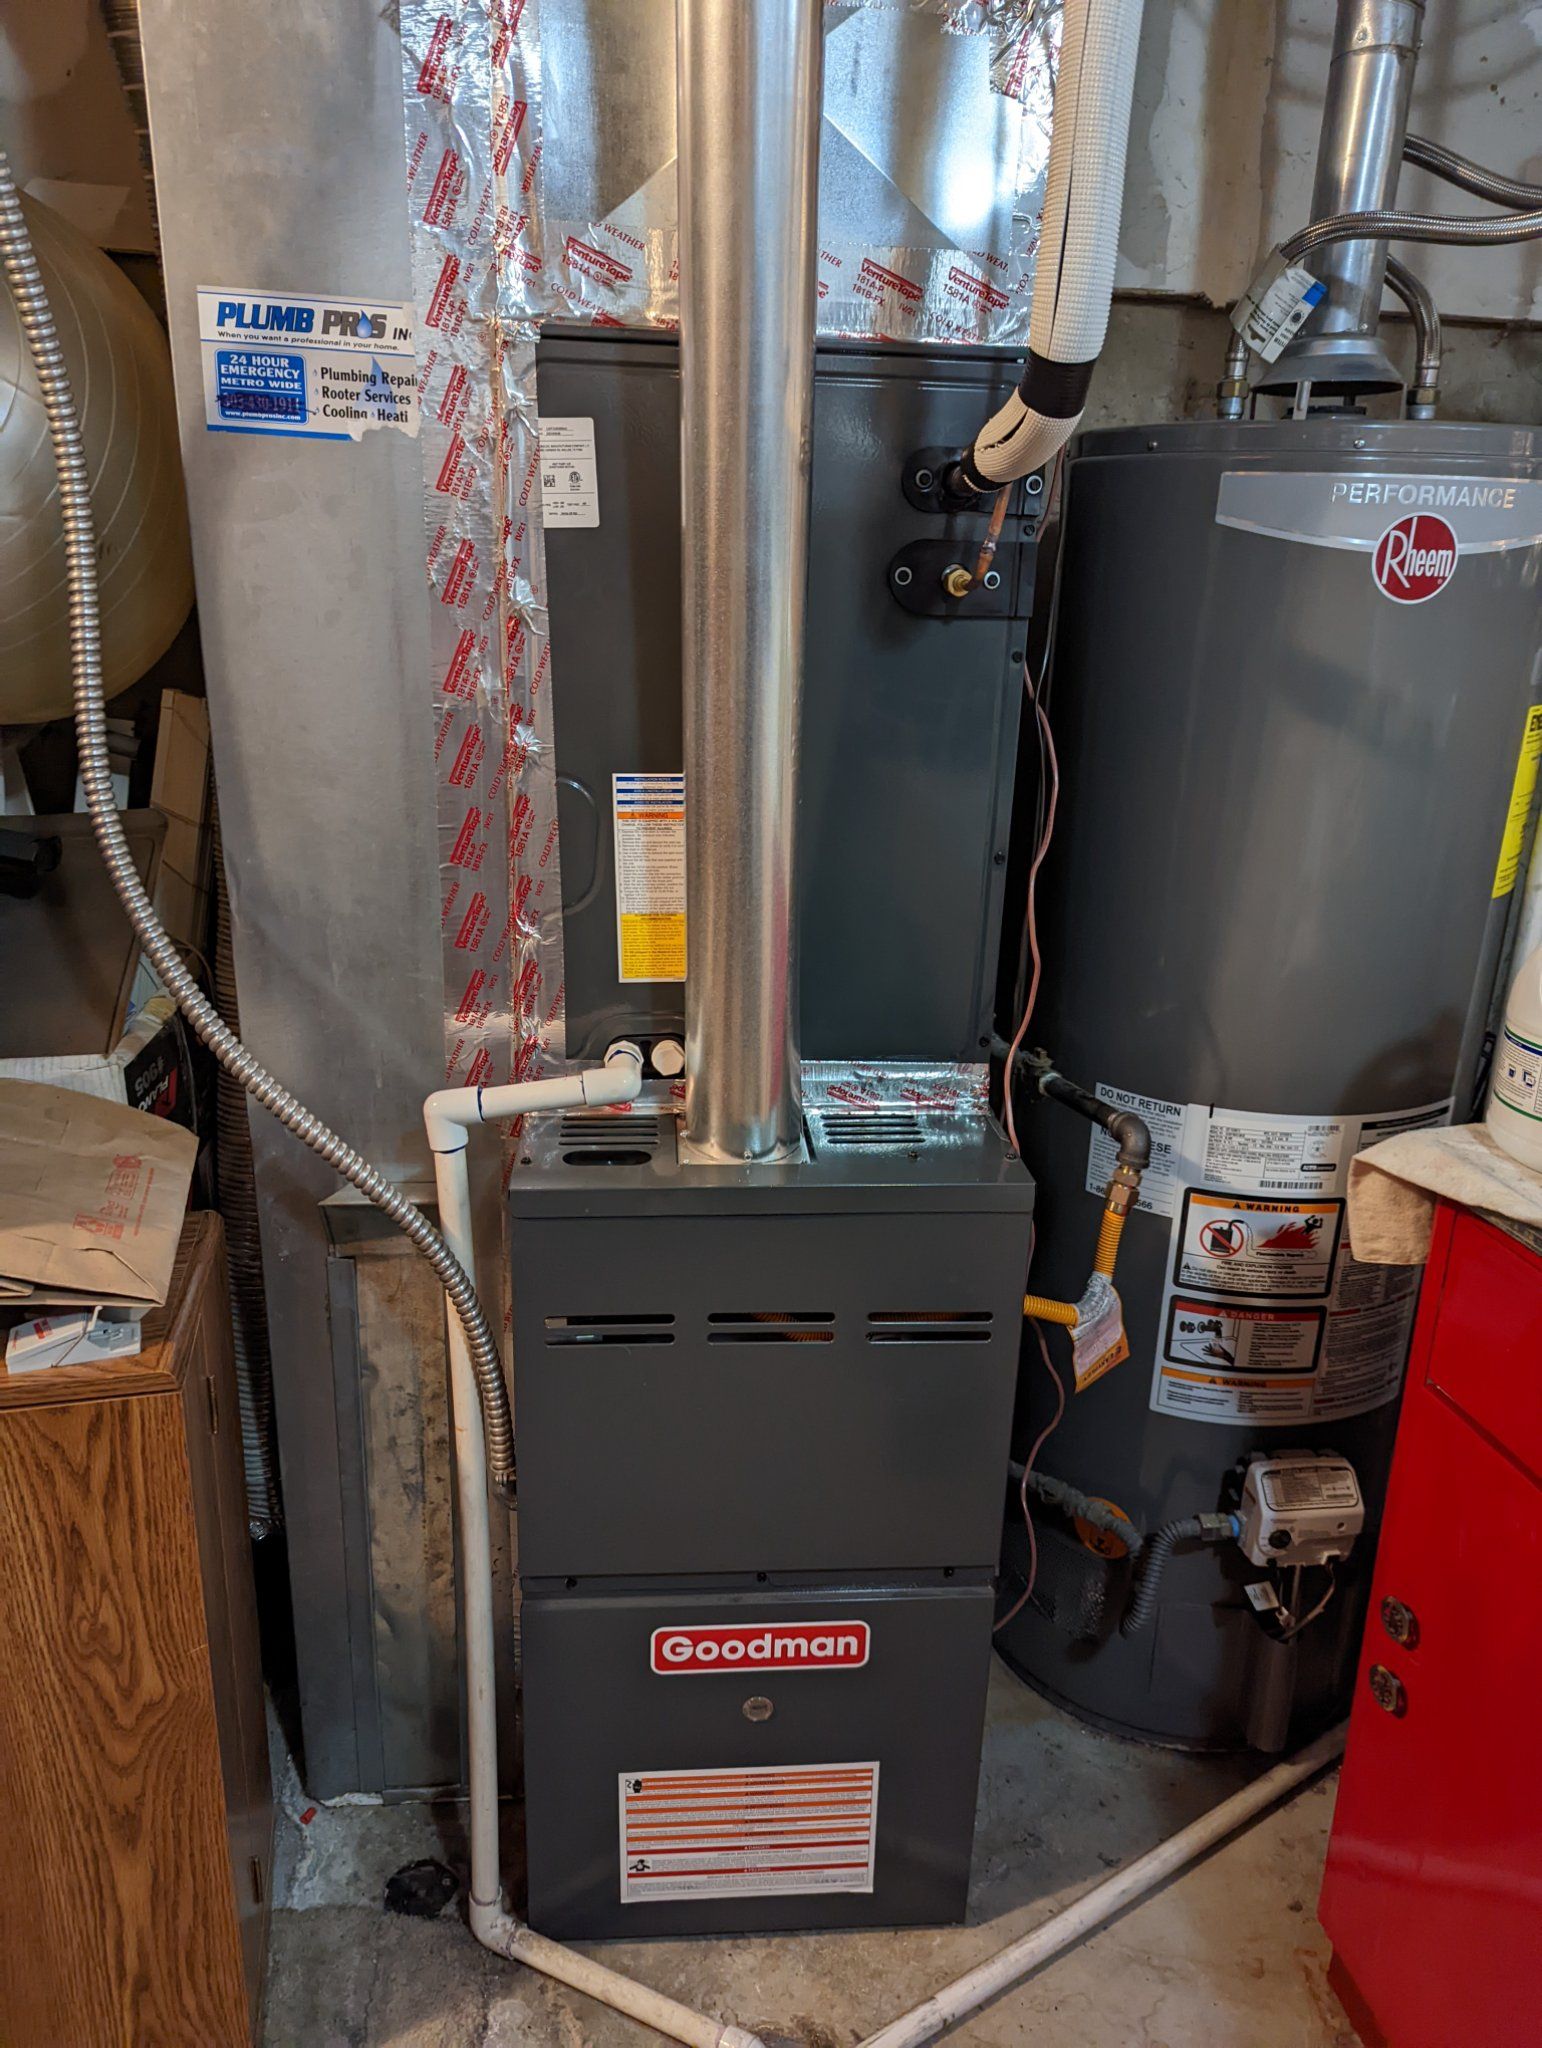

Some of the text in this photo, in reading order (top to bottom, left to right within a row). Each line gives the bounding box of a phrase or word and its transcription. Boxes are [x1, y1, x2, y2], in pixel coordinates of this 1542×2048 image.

[521, 145, 542, 193] WEATHER
[430, 151, 460, 226] VentureTape
[441, 198, 458, 231] 1581A
[467, 179, 493, 246] COLD WEAT
[603, 223, 645, 252] WEATHER
[566, 242, 633, 283] VentureTape
[820, 250, 842, 268] THER
[986, 253, 1009, 273] WEAT
[432, 254, 462, 328] VentureTape
[852, 283, 886, 307] 181B-FX
[857, 273, 886, 293] 181A-P
[861, 263, 923, 303] VentureTape
[943, 283, 969, 305] 1581A
[948, 271, 1009, 311] VentureTape
[551, 282, 609, 316] COLD WEAT
[899, 303, 917, 318] IV/21
[216, 301, 315, 334] PLUMB
[441, 298, 457, 333] 181A-P
[451, 298, 469, 338] 181B-FX
[291, 337, 342, 346] professional
[373, 343, 399, 351] home.
[221, 364, 300, 379] EMERGENCY
[230, 354, 289, 368] 24 HOUR
[418, 350, 438, 394] WEATHER
[221, 377, 302, 390] METRO WIDE
[321, 366, 377, 387] Plumbing
[322, 386, 411, 405] Rooter Services
[443, 365, 468, 427] ntureTape
[377, 408, 408, 423] Heati
[440, 436, 467, 492] VentureTa
[451, 468, 466, 498] 181A-P
[461, 466, 478, 501] 181B-FX
[519, 479, 532, 507] COLD
[1331, 482, 1517, 509] PERFORMANCE
[428, 525, 447, 567] WEATHER
[515, 522, 527, 542] IV/21
[1380, 516, 1453, 589] Rheem
[447, 539, 475, 604] VentureTape
[458, 581, 474, 609] 1581A
[482, 594, 497, 621] COLD
[479, 635, 490, 654] IV/21
[448, 630, 476, 694] VentureTape
[457, 669, 471, 698] 181A-P
[530, 670, 543, 695] COLD
[526, 709, 537, 727] IV/21
[435, 711, 455, 755] WEATHER
[453, 724, 482, 786] VentureTape
[464, 763, 480, 790] 1581A
[488, 776, 501, 800] COLD
[484, 812, 495, 830] IV/21
[456, 807, 482, 865] VentureTape
[515, 831, 530, 858] 1581A
[463, 843, 476, 868] 181A-P
[472, 842, 488, 872] 181B-FX
[539, 844, 552, 867] COLD
[459, 892, 486, 948] VentureTape
[470, 927, 485, 952] 1581A
[492, 939, 506, 962] COLD
[460, 969, 487, 1023] VentureTape
[488, 974, 499, 990] IV/21
[468, 1002, 482, 1026] 181A-P
[476, 1001, 493, 1029] 181B-FX
[523, 993, 536, 1018] 1581A
[447, 1038, 465, 1071] WEATHER
[470, 1048, 490, 1086] tureTape
[1100, 1087, 1181, 1117] DO NOT RETURN
[1246, 1203, 1300, 1213] WARNING
[1231, 1311, 1275, 1320] DANGER
[1222, 1378, 1267, 1388] WARNING
[662, 1633, 858, 1662] Goodman
